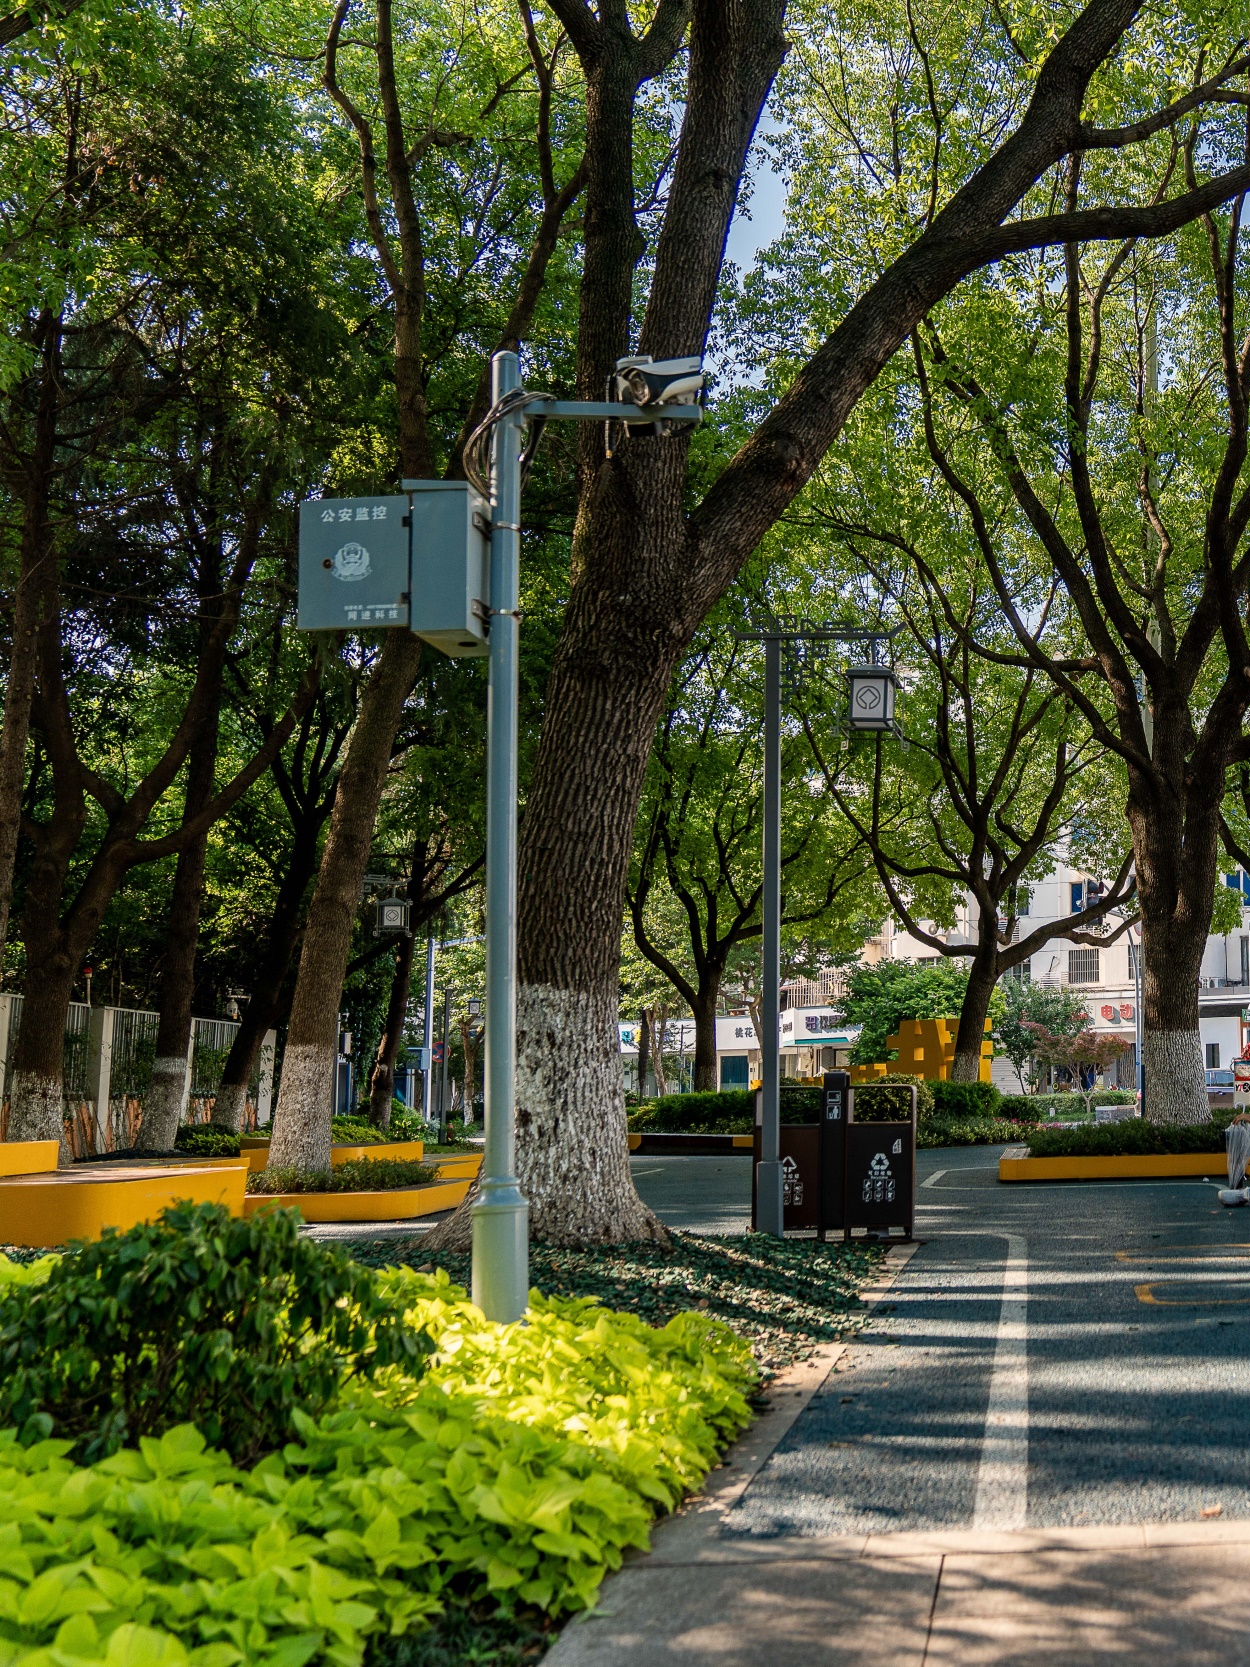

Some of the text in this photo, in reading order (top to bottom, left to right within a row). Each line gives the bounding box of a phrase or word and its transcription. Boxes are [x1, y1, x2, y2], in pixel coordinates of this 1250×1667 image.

[321, 505, 388, 523] 公安监控
[735, 1026, 757, 1038] 桃花
